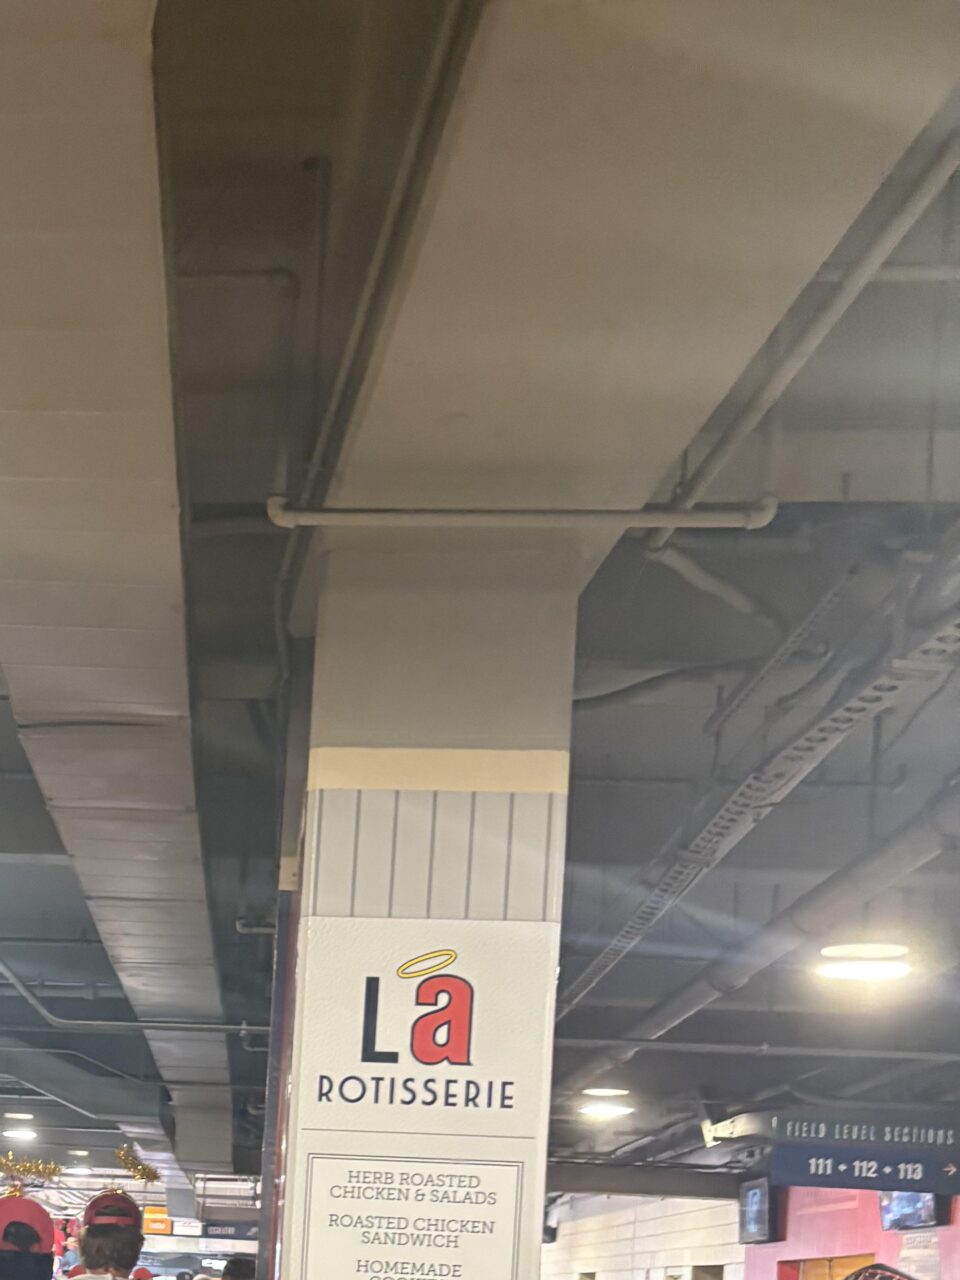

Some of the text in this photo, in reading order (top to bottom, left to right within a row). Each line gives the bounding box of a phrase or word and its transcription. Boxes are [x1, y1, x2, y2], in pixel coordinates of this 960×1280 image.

[317, 1074, 515, 1109] ROTISSERIE
[786, 1121, 955, 1145] FIELD LEVEL SECTIONS
[808, 1157, 924, 1180] 111 112 113
[347, 1170, 481, 1188] HERB ROASTED
[329, 1185, 498, 1205] CHICKEN & SALADS
[328, 1213, 496, 1234] ROASTED CHICKEN
[361, 1231, 460, 1248] SANDWICH
[355, 1259, 463, 1278] HOMEMADE
